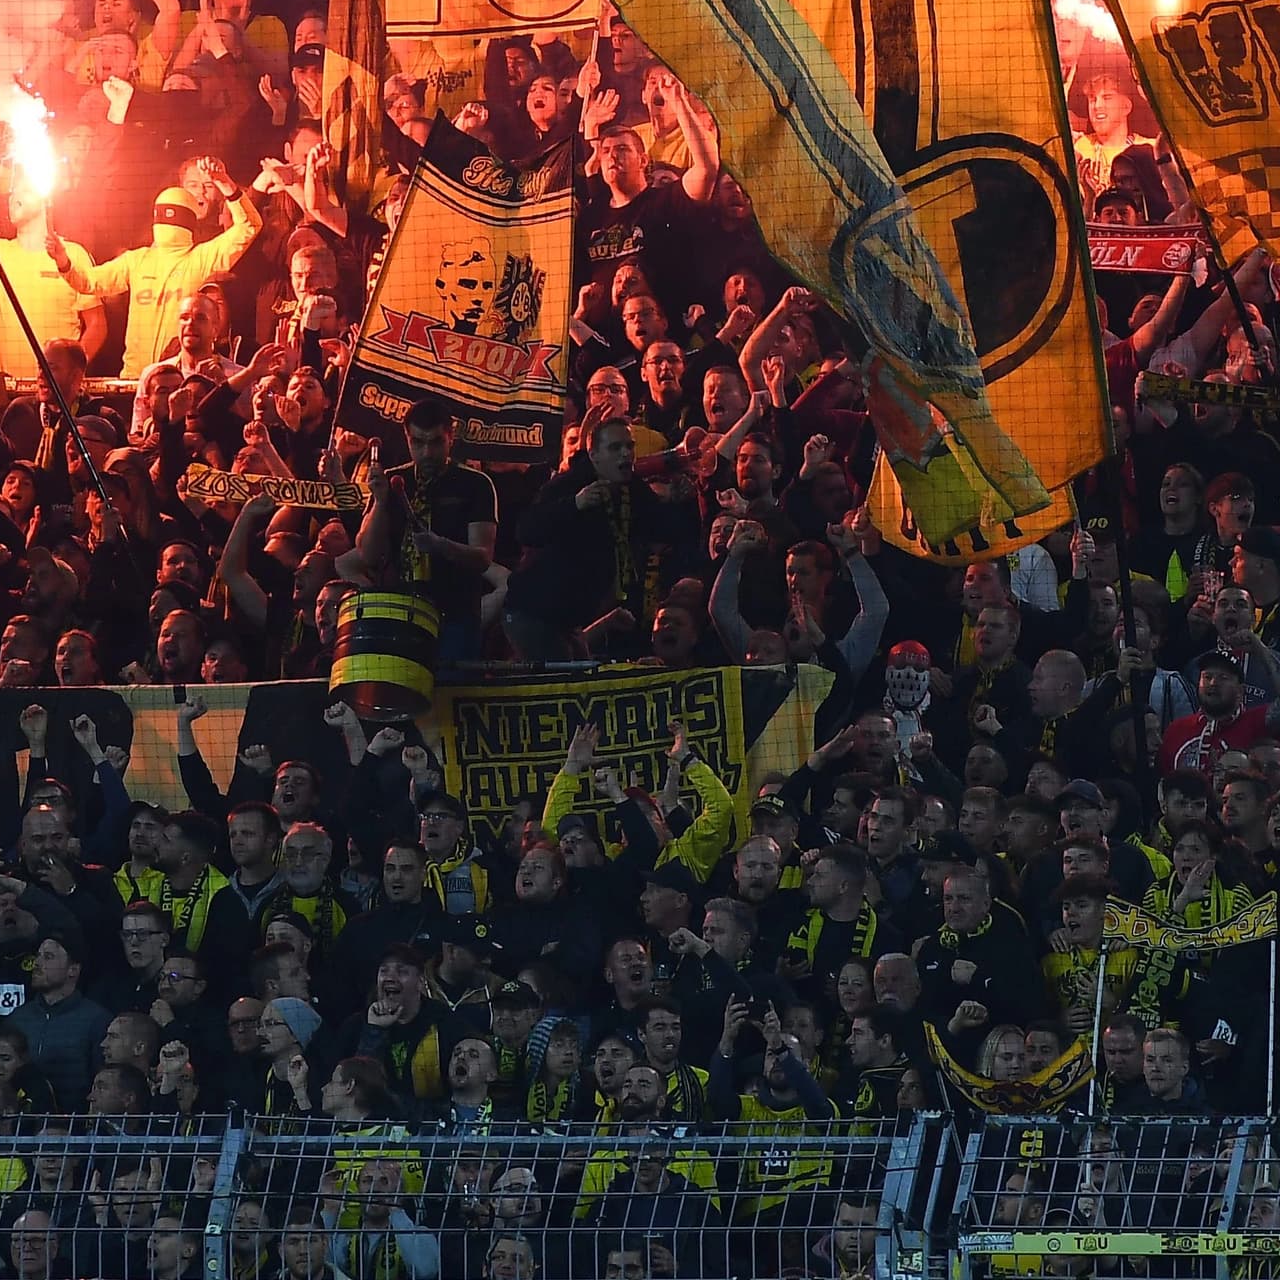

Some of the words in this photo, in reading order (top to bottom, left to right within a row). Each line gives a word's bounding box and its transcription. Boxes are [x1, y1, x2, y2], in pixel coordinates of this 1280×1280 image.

[1089, 240, 1145, 268] ÖLN
[443, 336, 522, 375] 2001
[360, 382, 414, 423] Supp
[462, 675, 721, 758] NIEMALS
